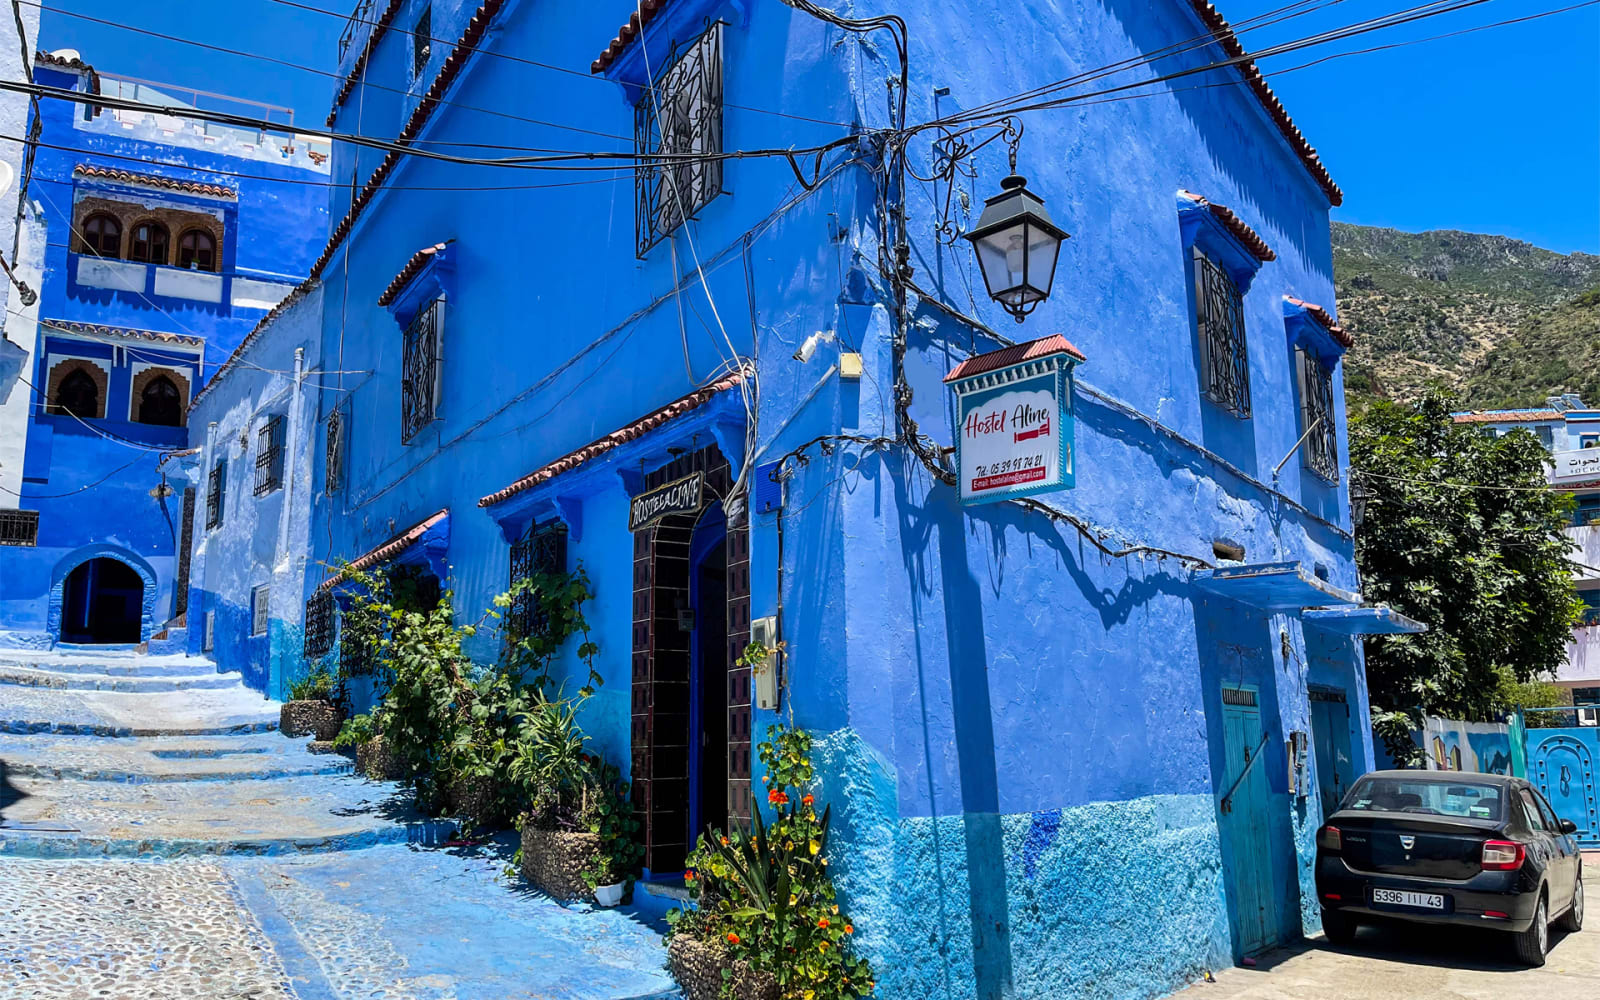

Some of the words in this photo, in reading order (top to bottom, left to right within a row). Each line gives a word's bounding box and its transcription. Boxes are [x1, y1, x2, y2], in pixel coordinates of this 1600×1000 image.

[965, 410, 1006, 438] Hostel
[1011, 404, 1049, 428] Aline
[990, 463, 999, 474] 05
[1001, 460, 1010, 473] 39
[1013, 457, 1022, 470] 98
[1024, 457, 1033, 468] 74
[1034, 454, 1042, 466] 21
[632, 494, 664, 527] HOSTEL
[661, 475, 700, 509] ALINE
[1375, 890, 1403, 903] 5396
[1427, 895, 1442, 907] 43
